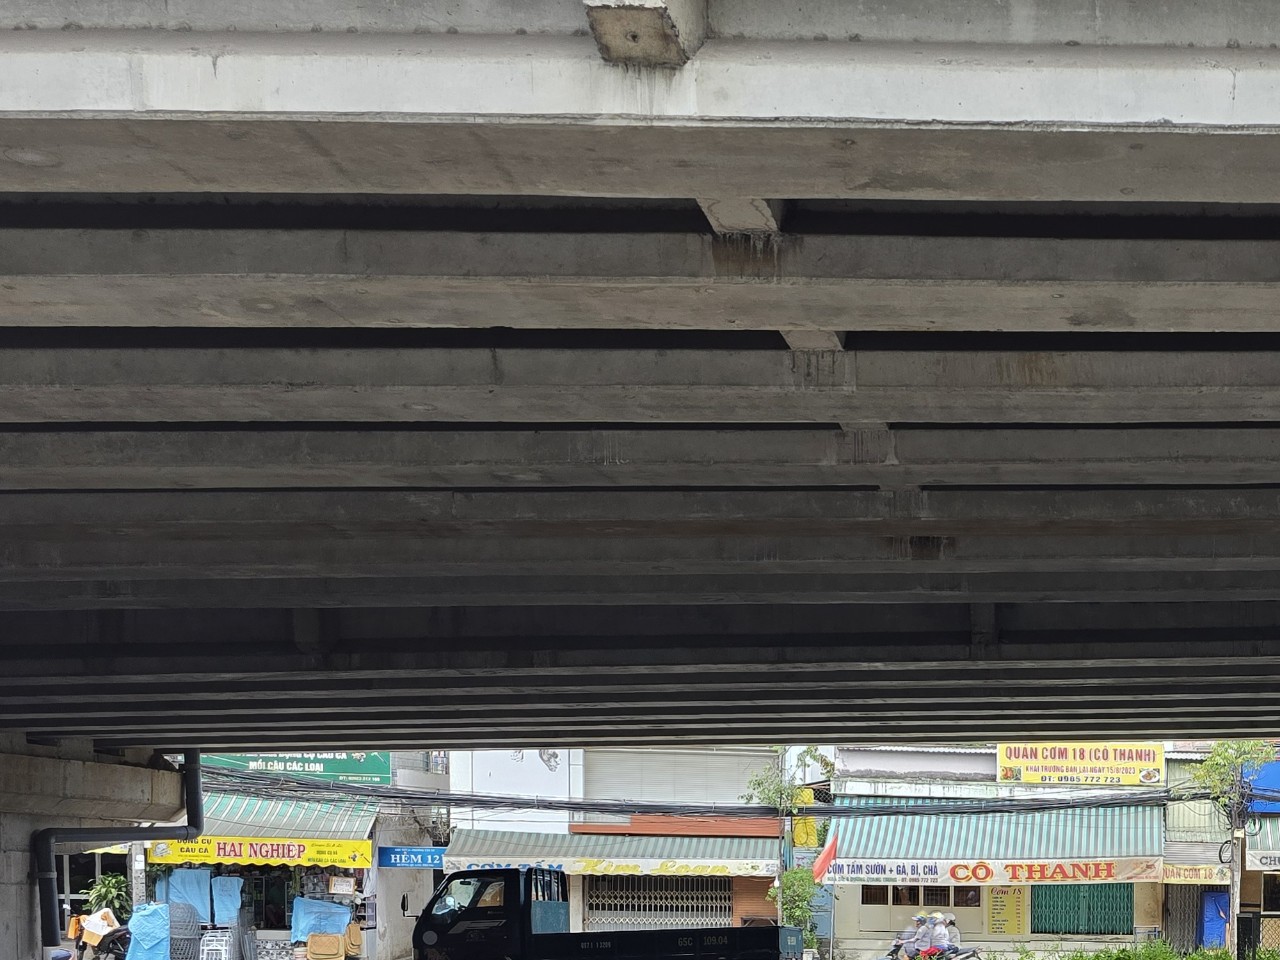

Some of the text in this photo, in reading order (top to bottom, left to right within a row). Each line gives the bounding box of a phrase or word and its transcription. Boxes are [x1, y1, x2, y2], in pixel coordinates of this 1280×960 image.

[1041, 746, 1068, 760] CƠM
[1072, 747, 1085, 760] 18
[1113, 748, 1156, 763] THANH)
[1084, 776, 1101, 784] 772
[949, 861, 1117, 883] CÔ THANH
[677, 937, 694, 947] 65C
